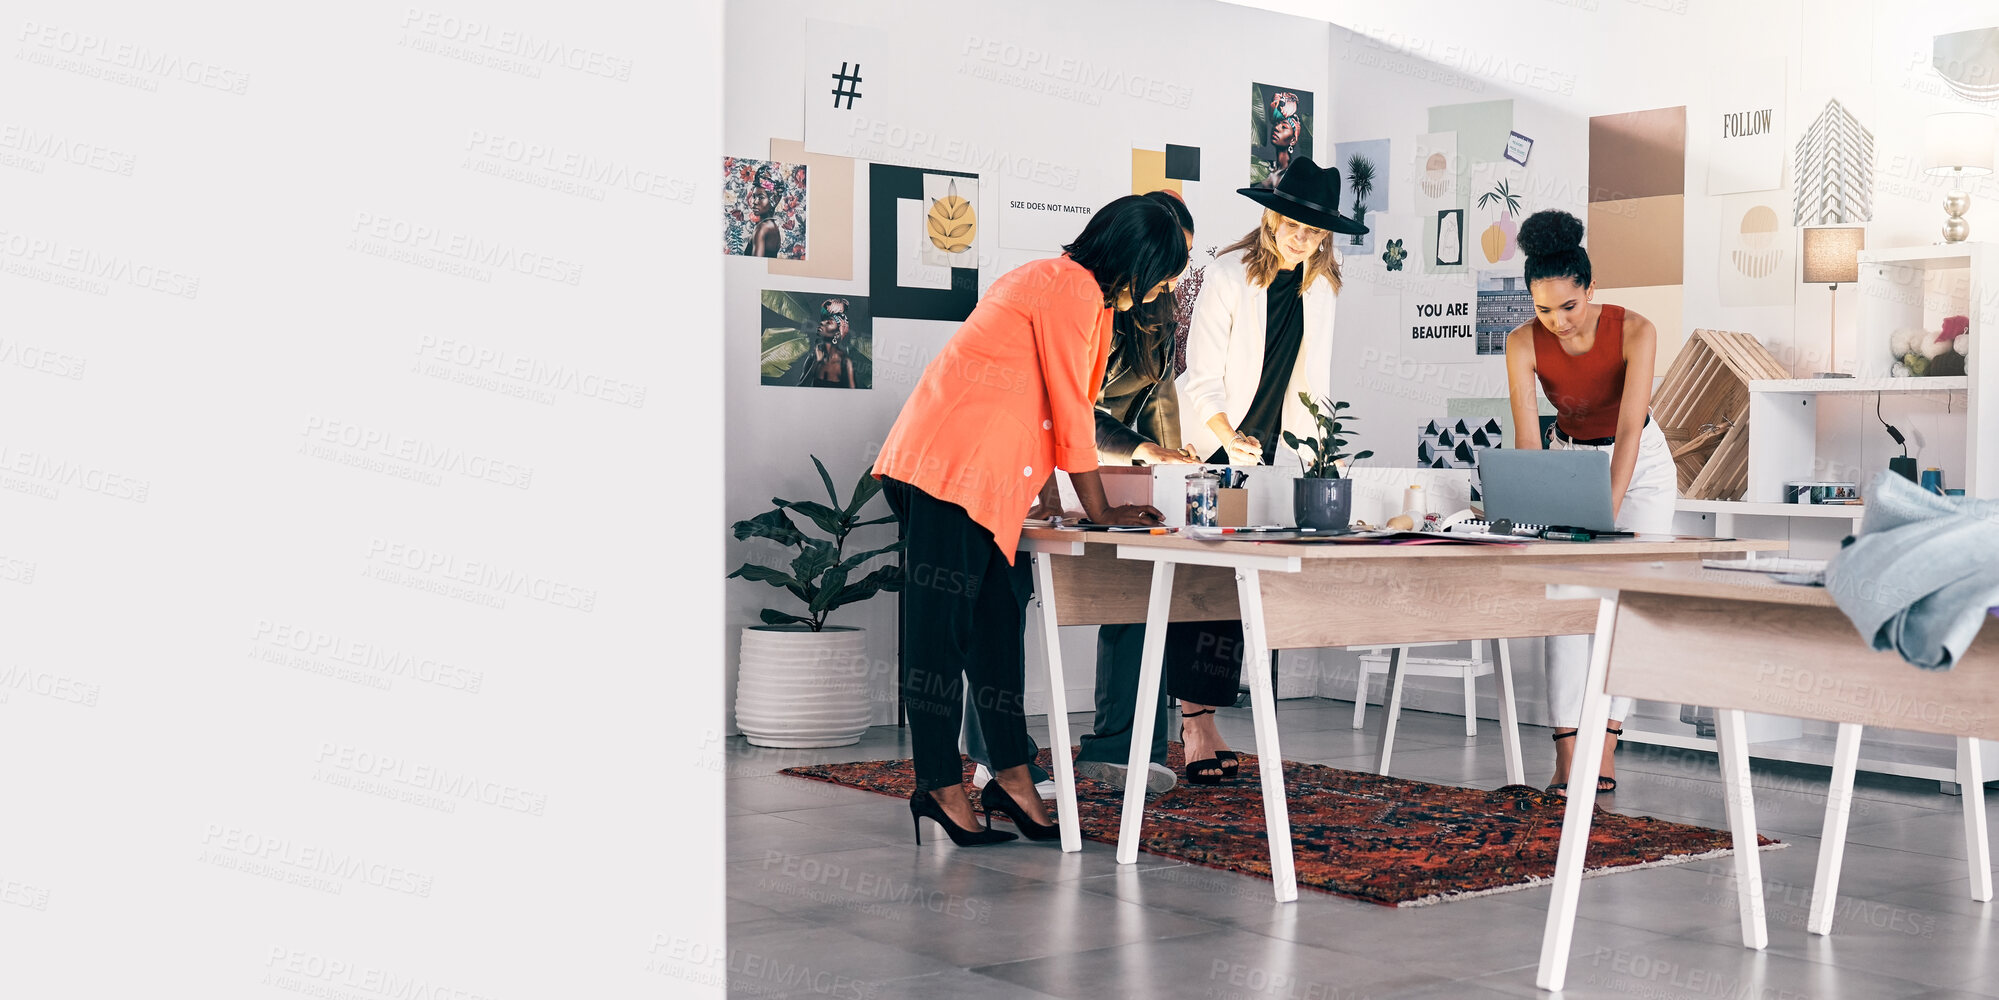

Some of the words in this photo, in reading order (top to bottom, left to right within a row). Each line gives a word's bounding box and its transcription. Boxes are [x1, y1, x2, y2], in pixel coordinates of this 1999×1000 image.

[1723, 109, 1773, 138] FOLLOW
[1010, 201, 1025, 209] SIZE
[1026, 202, 1046, 211] DOES
[1047, 204, 1062, 212] NOT
[1063, 205, 1091, 215] MATTER
[1416, 303, 1443, 317] YOU
[1446, 302, 1469, 316] ARE
[1412, 325, 1473, 339] BEAUTIFUL
